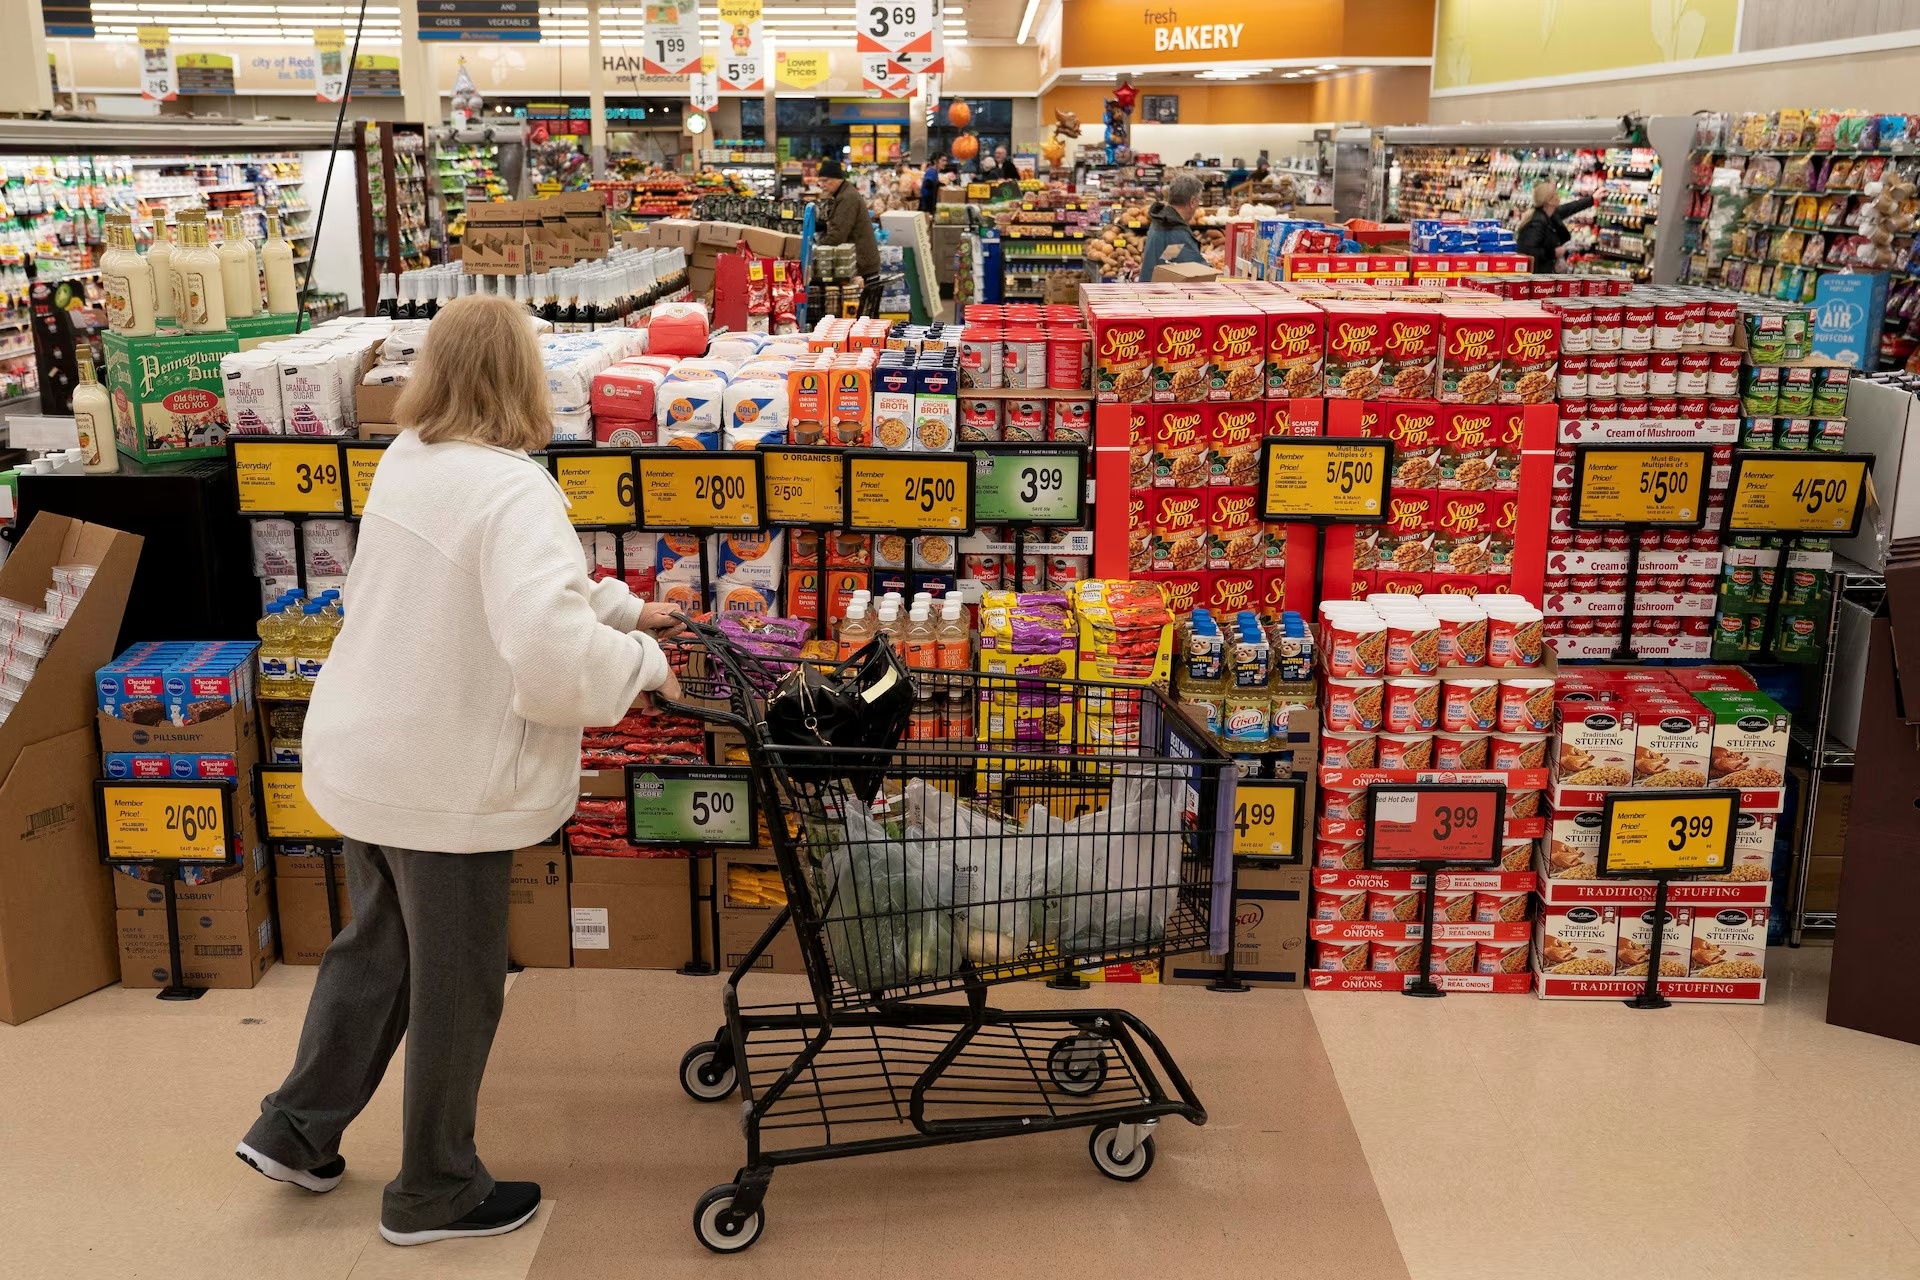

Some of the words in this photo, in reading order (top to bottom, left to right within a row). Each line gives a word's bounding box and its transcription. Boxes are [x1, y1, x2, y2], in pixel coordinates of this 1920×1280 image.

[721, 10, 760, 18] Savings
[1143, 9, 1177, 25] fresh
[1154, 23, 1244, 52] BAKERY
[787, 59, 816, 67] Lower
[787, 68, 816, 76] Prices
[641, 74, 686, 82] Redmond
[1822, 312, 1851, 328] AIR
[1101, 328, 1145, 355] Stove
[1157, 326, 1202, 353] Stove
[1213, 325, 1258, 353] Stove
[1271, 323, 1316, 352] Stove
[1332, 323, 1378, 352] Stove
[1815, 334, 1854, 343] PUFFCORN
[1173, 344, 1196, 360] Top
[1228, 342, 1252, 359] Top
[1285, 338, 1310, 359] Top
[1347, 339, 1371, 357] Top
[1116, 346, 1139, 361] Top
[1114, 362, 1141, 372] CHICKEN
[1346, 359, 1370, 368] TURKEY
[1399, 358, 1422, 367] TURKEY
[1463, 363, 1486, 373] TURKEY
[237, 396, 258, 404] SUGAR
[173, 402, 190, 410] EGG
[191, 400, 210, 409] NOG
[672, 404, 692, 413] GOLD
[738, 405, 757, 414] GOLD
[1294, 426, 1316, 434] CASH
[1606, 429, 1634, 438] Cream
[1637, 428, 1647, 438] of
[1648, 428, 1695, 438] Mushroom
[791, 454, 831, 462] ORGANICS
[237, 462, 272, 470] Everyday!
[1590, 561, 1619, 572] Cream
[1588, 602, 1616, 612] Cream
[1582, 644, 1610, 655] Cream
[127, 678, 155, 686] Chocolate
[194, 678, 222, 686] Chocolate
[1333, 704, 1348, 712] CRISPY
[1230, 714, 1259, 729] Crisco
[153, 733, 201, 742] PILLSBURY
[1575, 737, 1623, 747] STUFFING
[1650, 740, 1699, 749] STUFFING
[1726, 739, 1775, 748] STUFFING
[136, 760, 163, 768] Chocolate
[141, 765, 158, 773] Fudge
[267, 782, 296, 790] Member
[114, 800, 143, 808] Member
[119, 810, 140, 818] Price!
[1617, 812, 1646, 820] Member
[1620, 822, 1640, 830] Price!
[546, 875, 560, 886] UP
[1348, 879, 1389, 888] ONIONS
[1675, 888, 1740, 897] STUFFING
[1343, 928, 1384, 938] ONIONS
[1342, 980, 1383, 989] ONIONS
[1669, 983, 1734, 993] STUFFING
